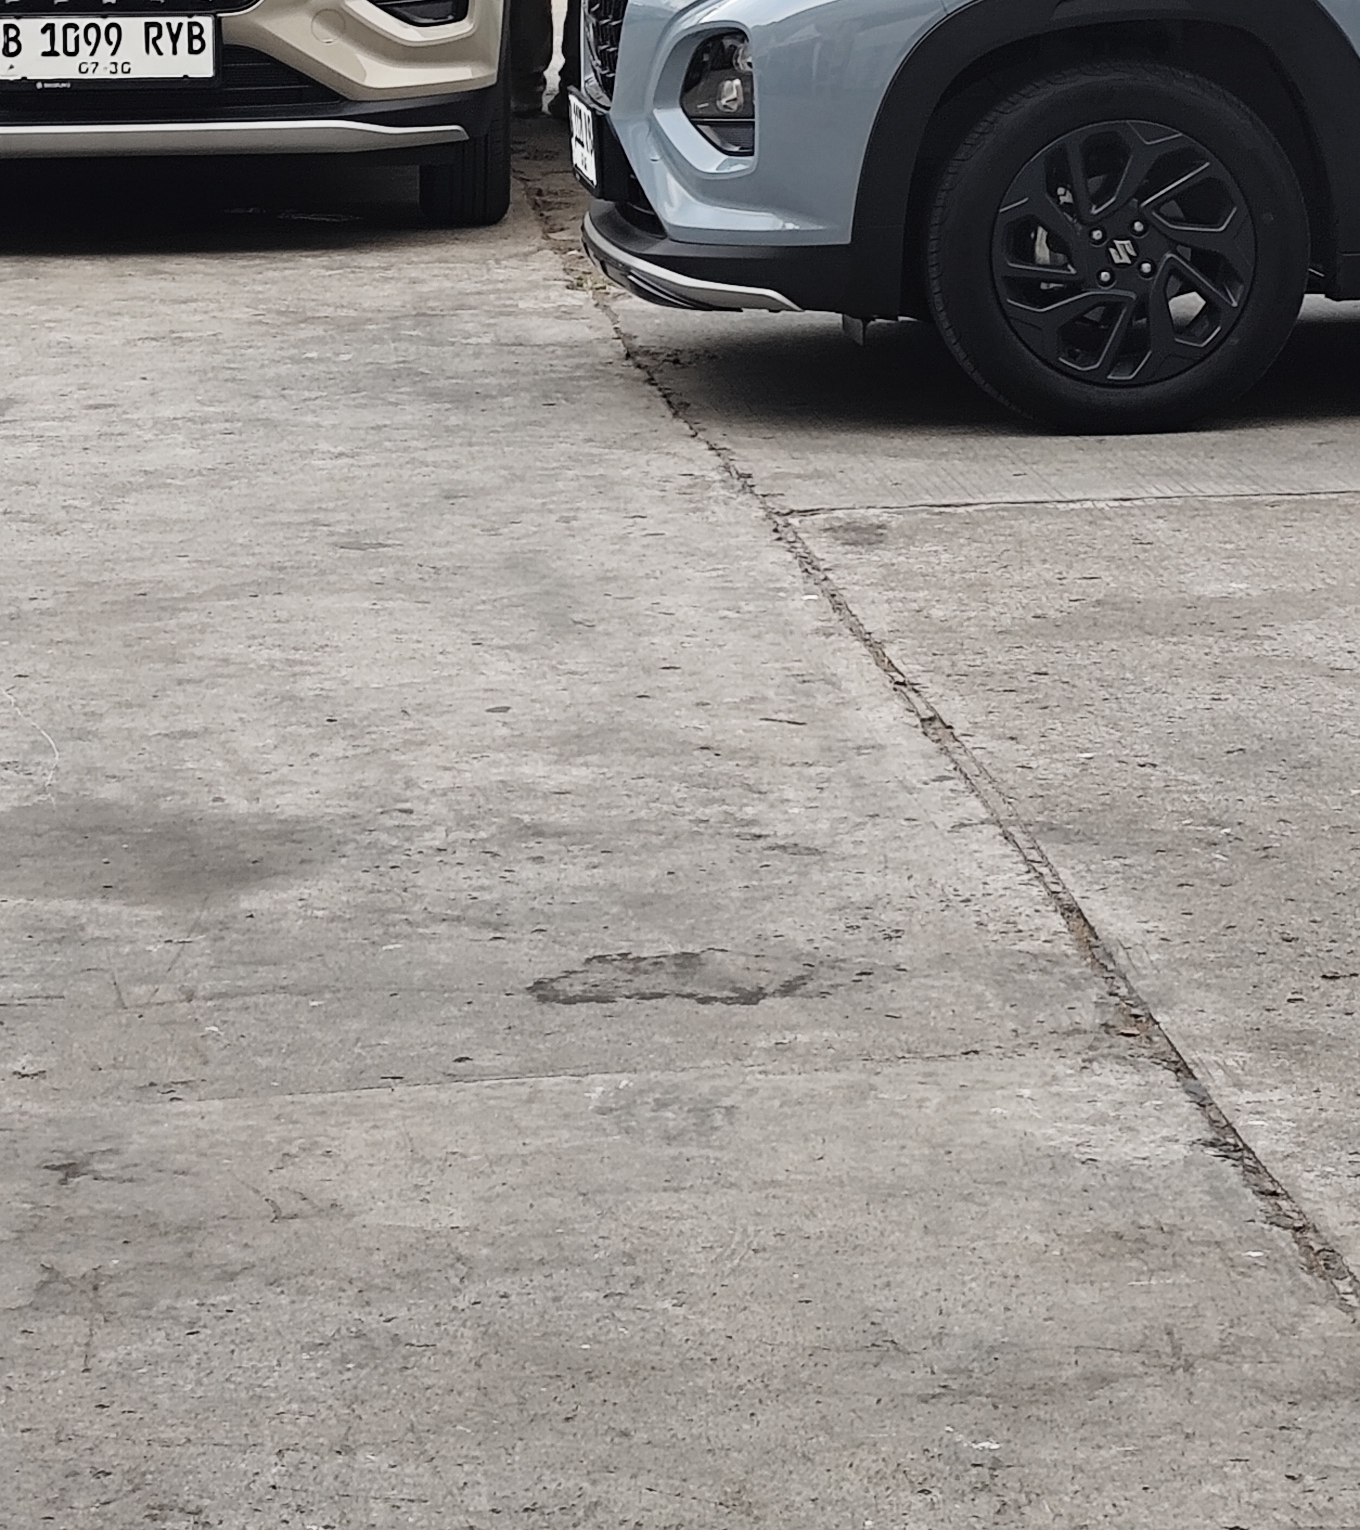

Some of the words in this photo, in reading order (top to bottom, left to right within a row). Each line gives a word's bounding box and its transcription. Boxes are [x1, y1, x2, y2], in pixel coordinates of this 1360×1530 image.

[2, 23, 22, 57] B
[40, 22, 122, 57] 1099
[144, 21, 206, 55] RYB
